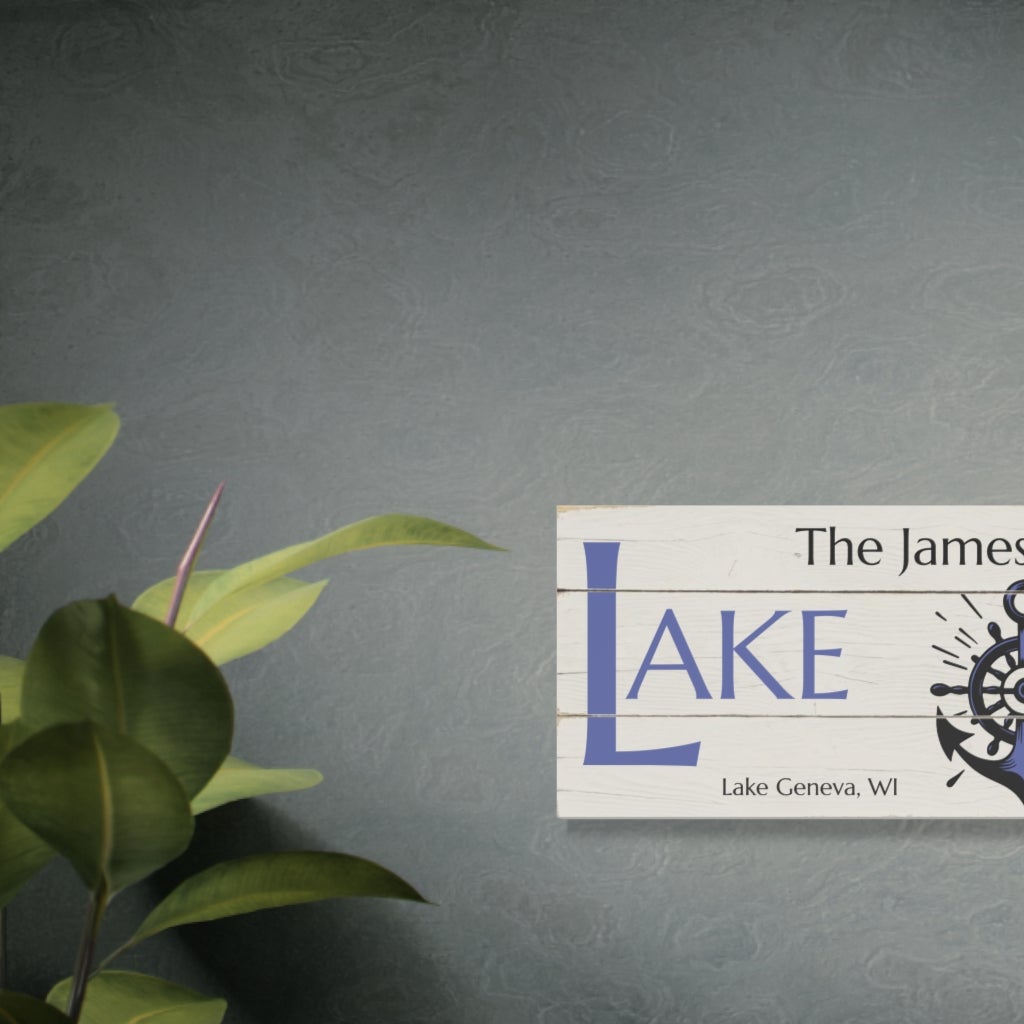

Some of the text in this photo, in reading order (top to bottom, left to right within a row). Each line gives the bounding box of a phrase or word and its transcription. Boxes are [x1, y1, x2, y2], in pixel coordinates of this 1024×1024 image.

[795, 526, 883, 566] The
[583, 541, 848, 767] LAKE
[722, 777, 898, 799] Lake Geneva, WI
